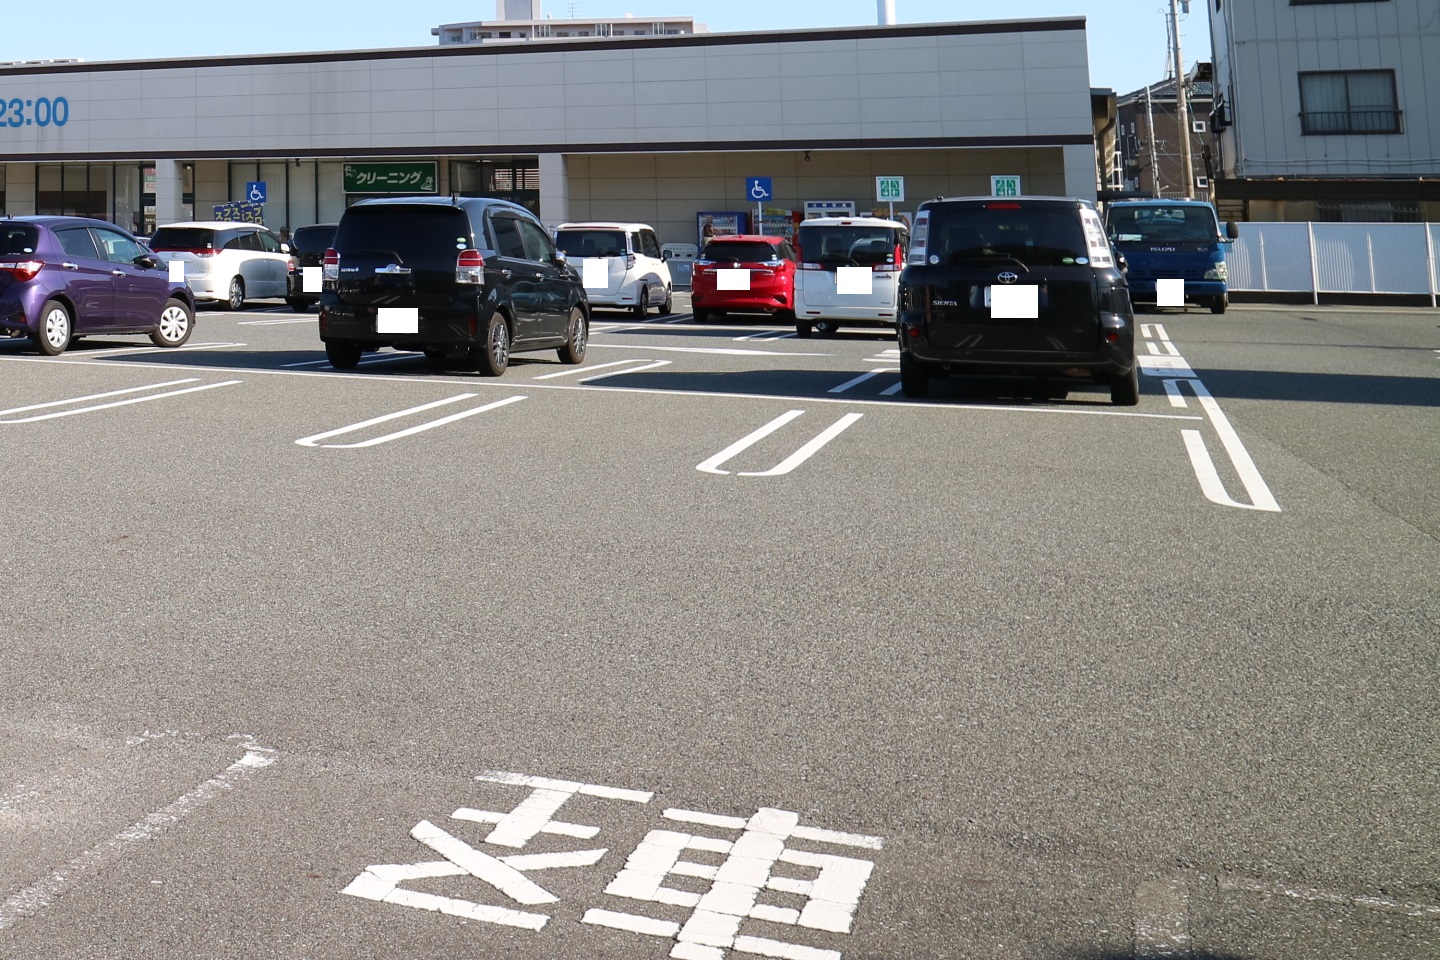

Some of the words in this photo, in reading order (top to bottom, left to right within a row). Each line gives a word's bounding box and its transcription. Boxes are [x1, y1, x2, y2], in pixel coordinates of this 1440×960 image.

[356, 171, 422, 184] クリーニング
